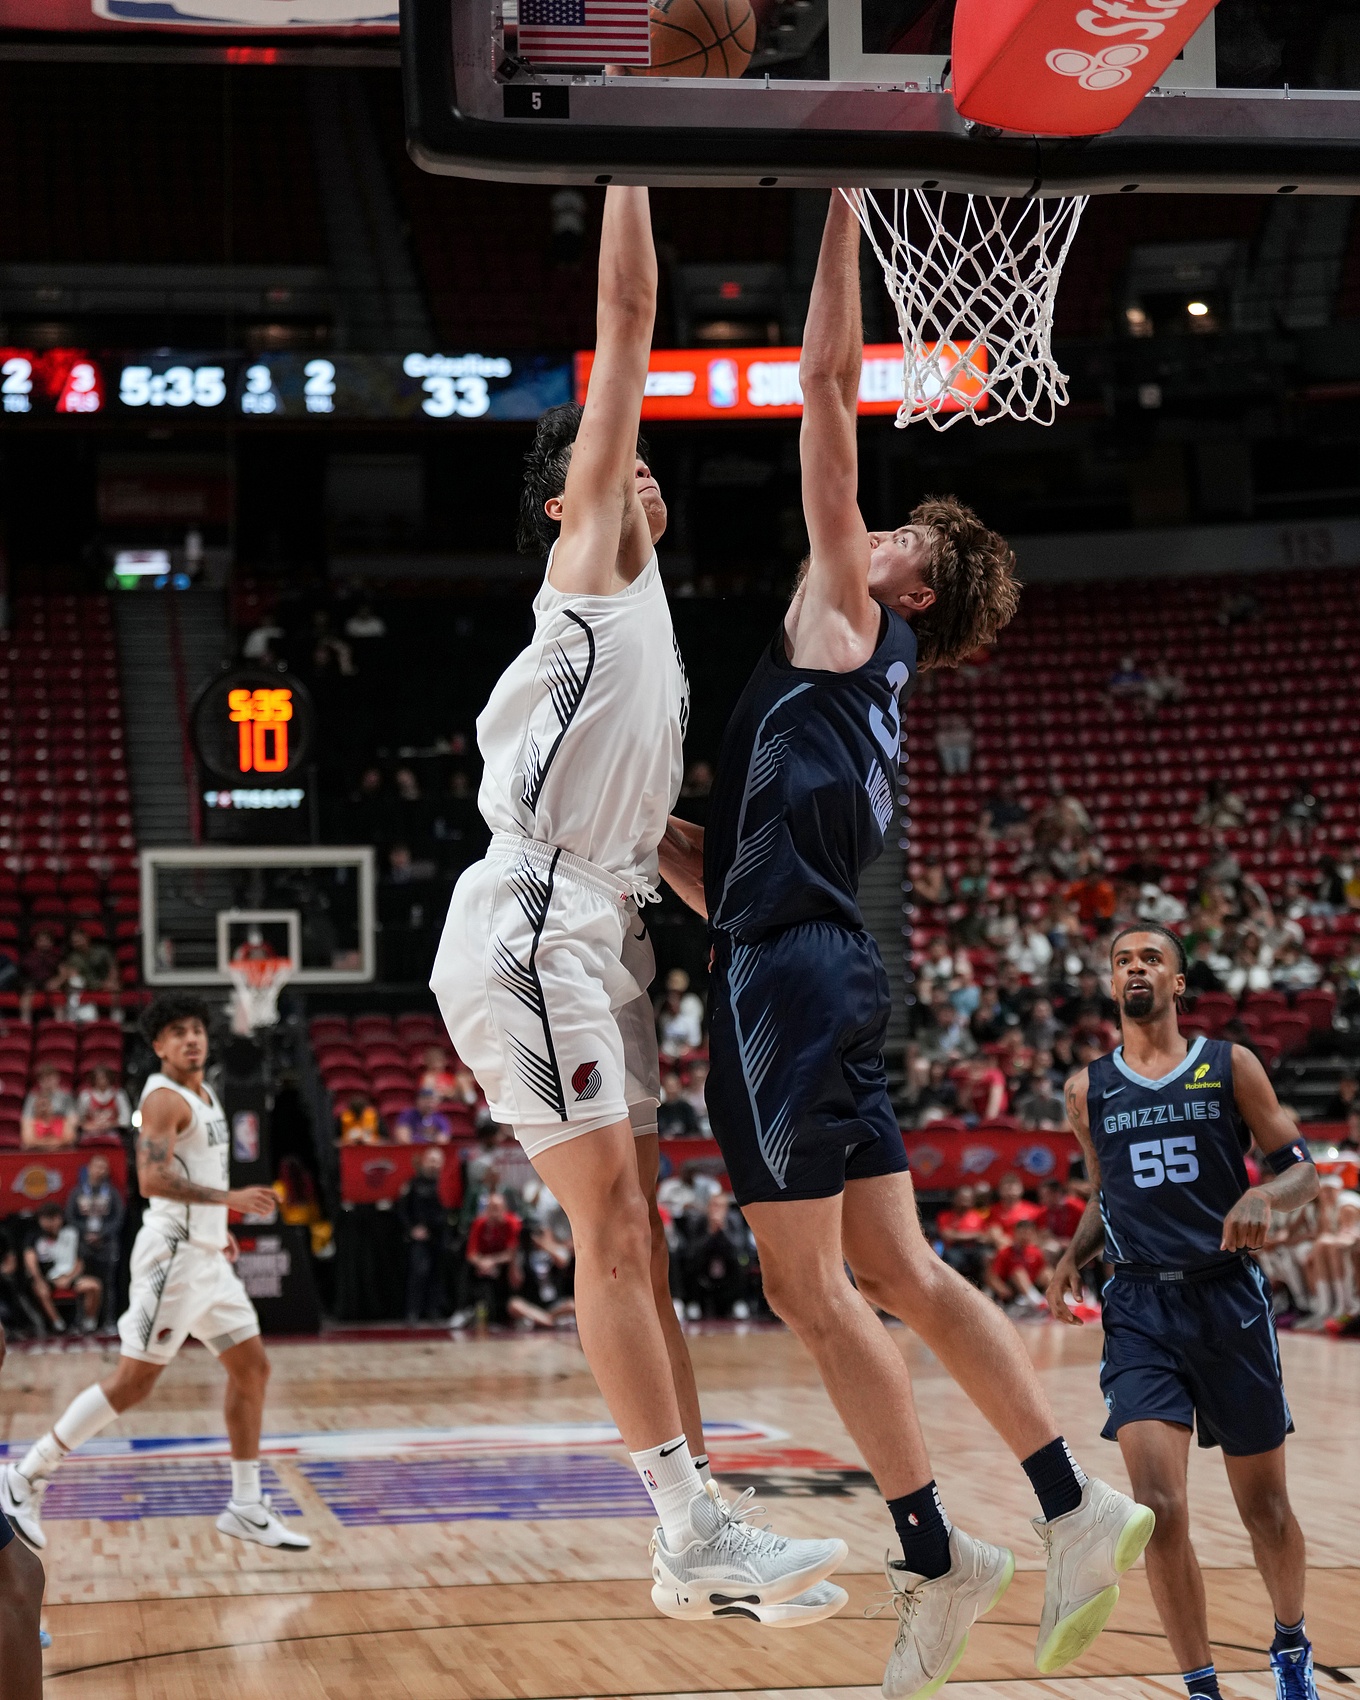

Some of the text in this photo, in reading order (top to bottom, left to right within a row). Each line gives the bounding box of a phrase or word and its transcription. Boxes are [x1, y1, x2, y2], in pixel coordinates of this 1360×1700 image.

[532, 91, 542, 110] 5
[1, 357, 33, 394] 2
[70, 363, 96, 393] 3
[118, 365, 227, 407] 5:35
[246, 364, 272, 394] 3
[304, 358, 336, 396] 2
[421, 376, 490, 418] 33
[228, 688, 293, 722] 5:35
[239, 720, 288, 773] 10
[1184, 1081, 1221, 1090] Robinhood
[1103, 1101, 1221, 1134] GRIZZLIES
[1129, 1136, 1199, 1188] 55
